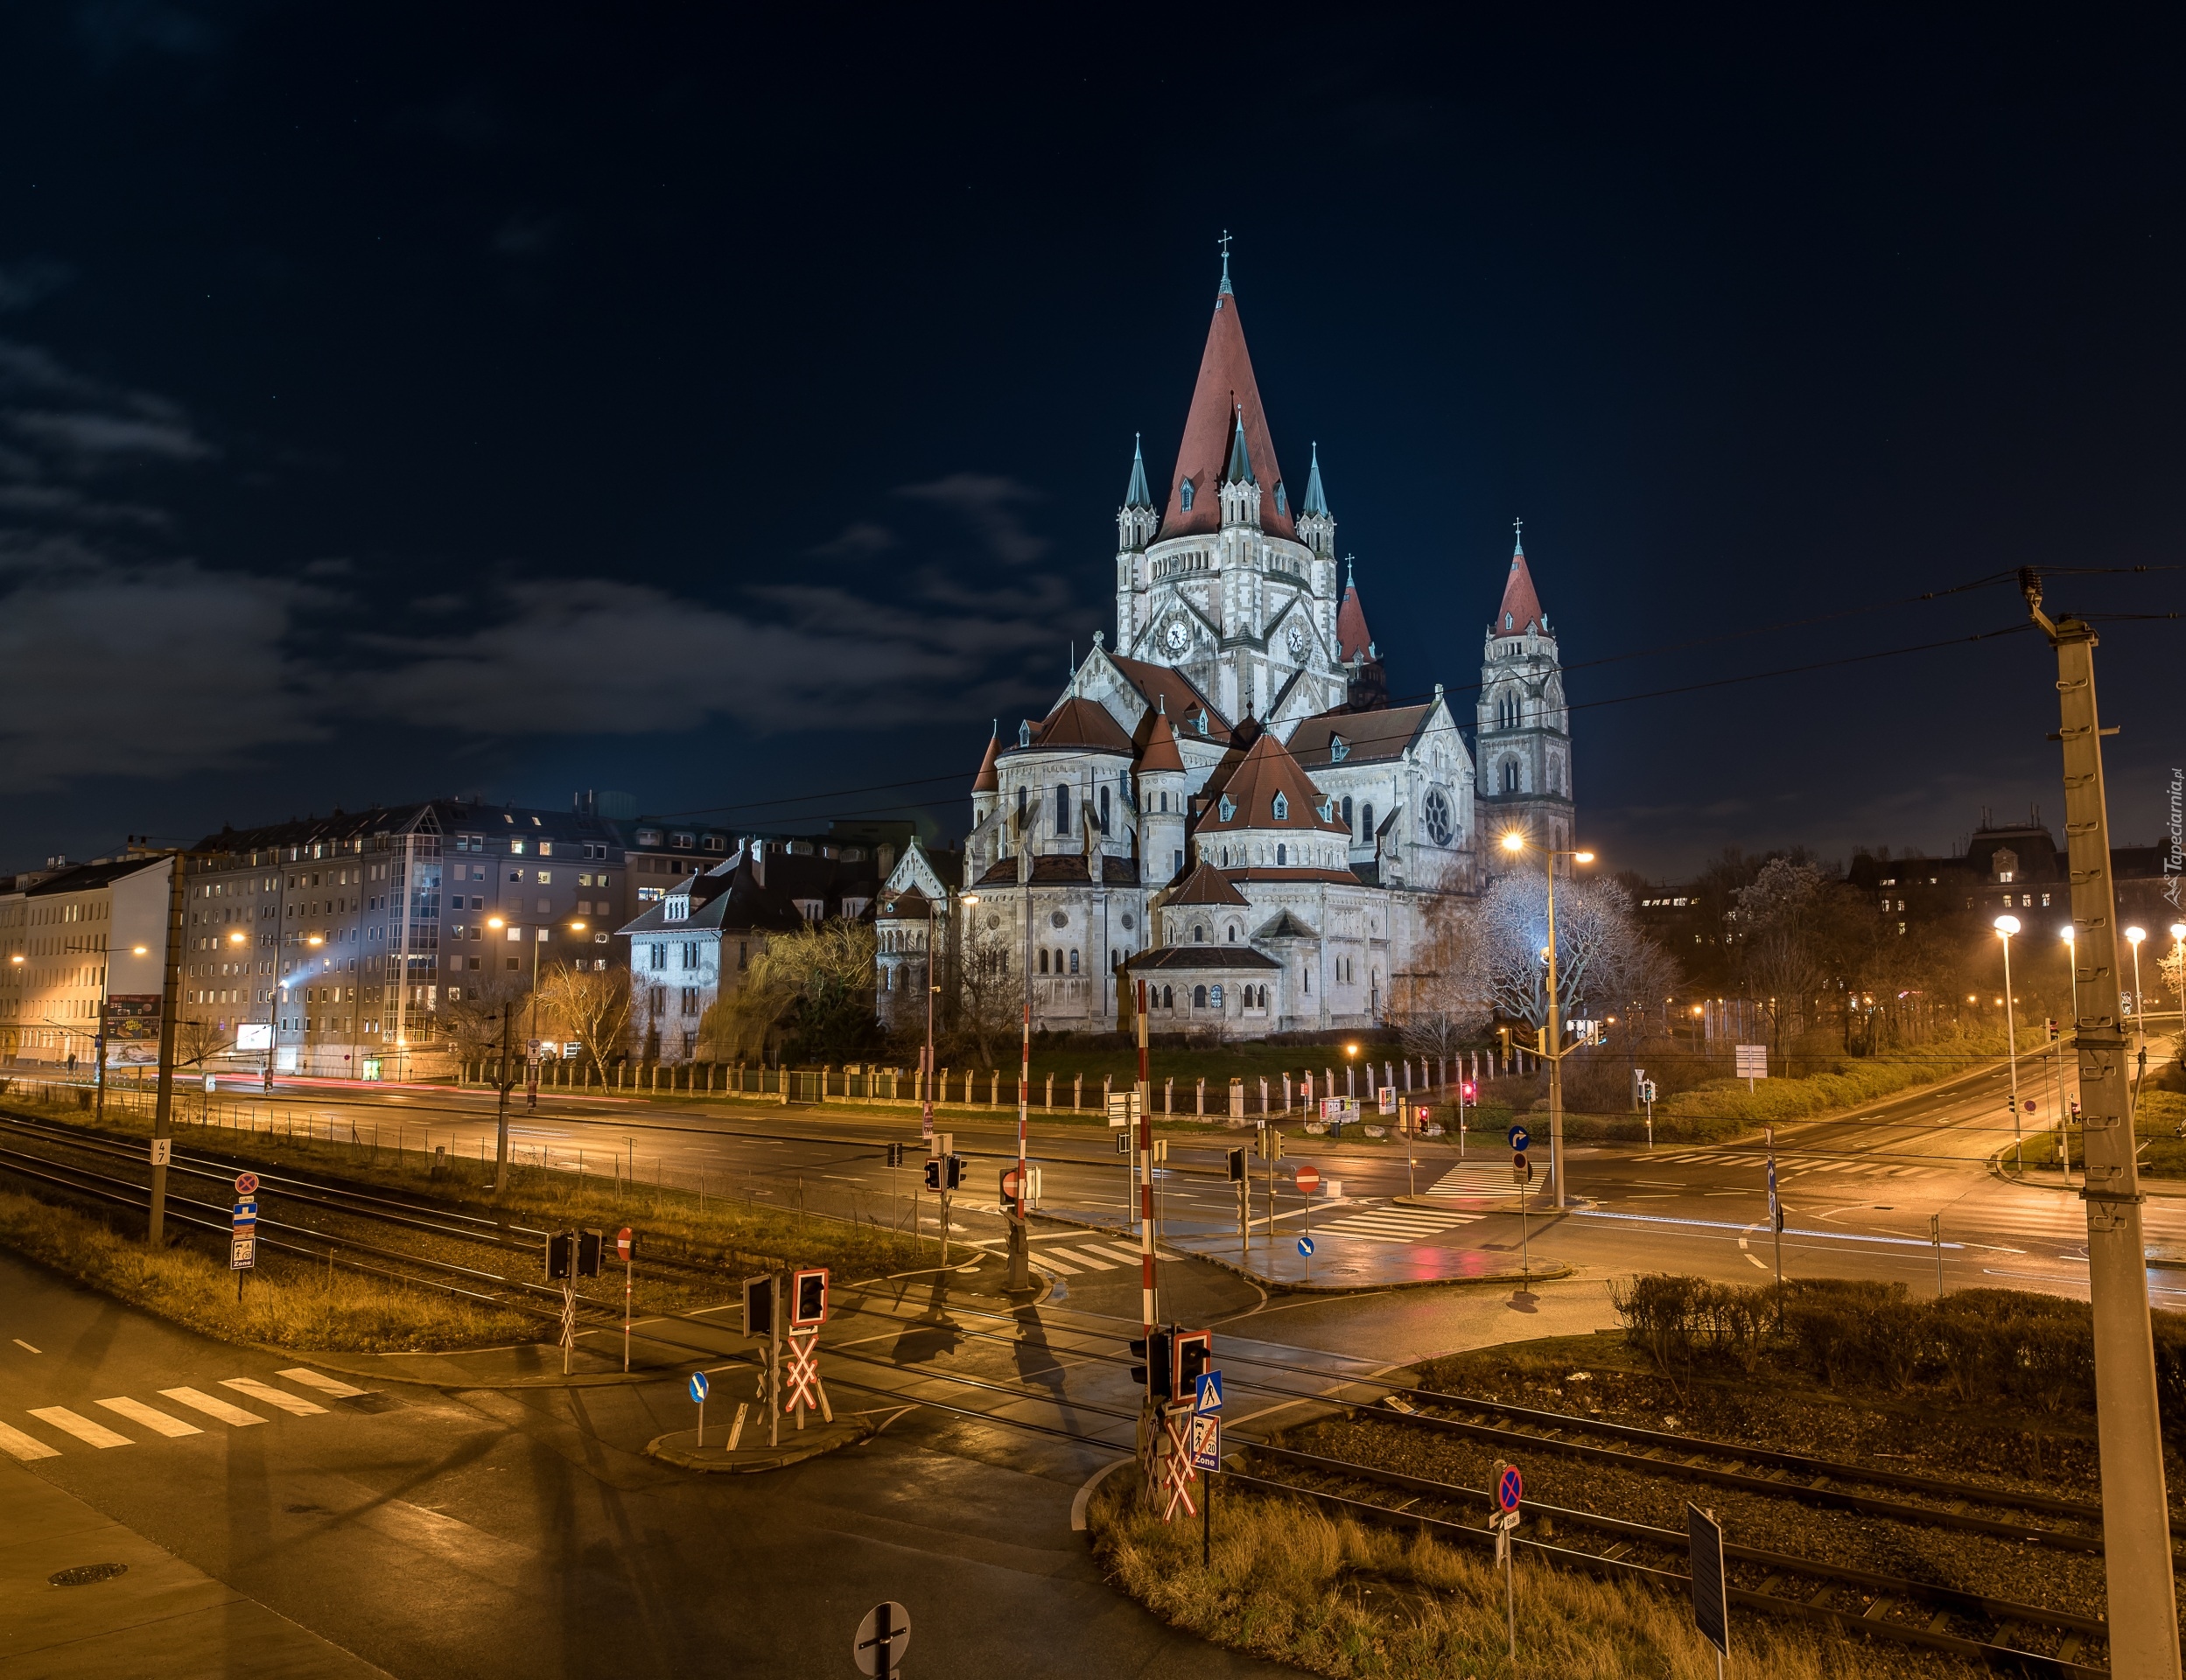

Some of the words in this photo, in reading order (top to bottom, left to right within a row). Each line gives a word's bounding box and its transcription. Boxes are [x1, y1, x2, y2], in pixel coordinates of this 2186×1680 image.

[158, 1141, 165, 1152] 4
[158, 1152, 165, 1163] 7
[1208, 1443, 1216, 1453] 20
[1195, 1454, 1216, 1466] Zone
[1507, 1516, 1517, 1526] Ende
